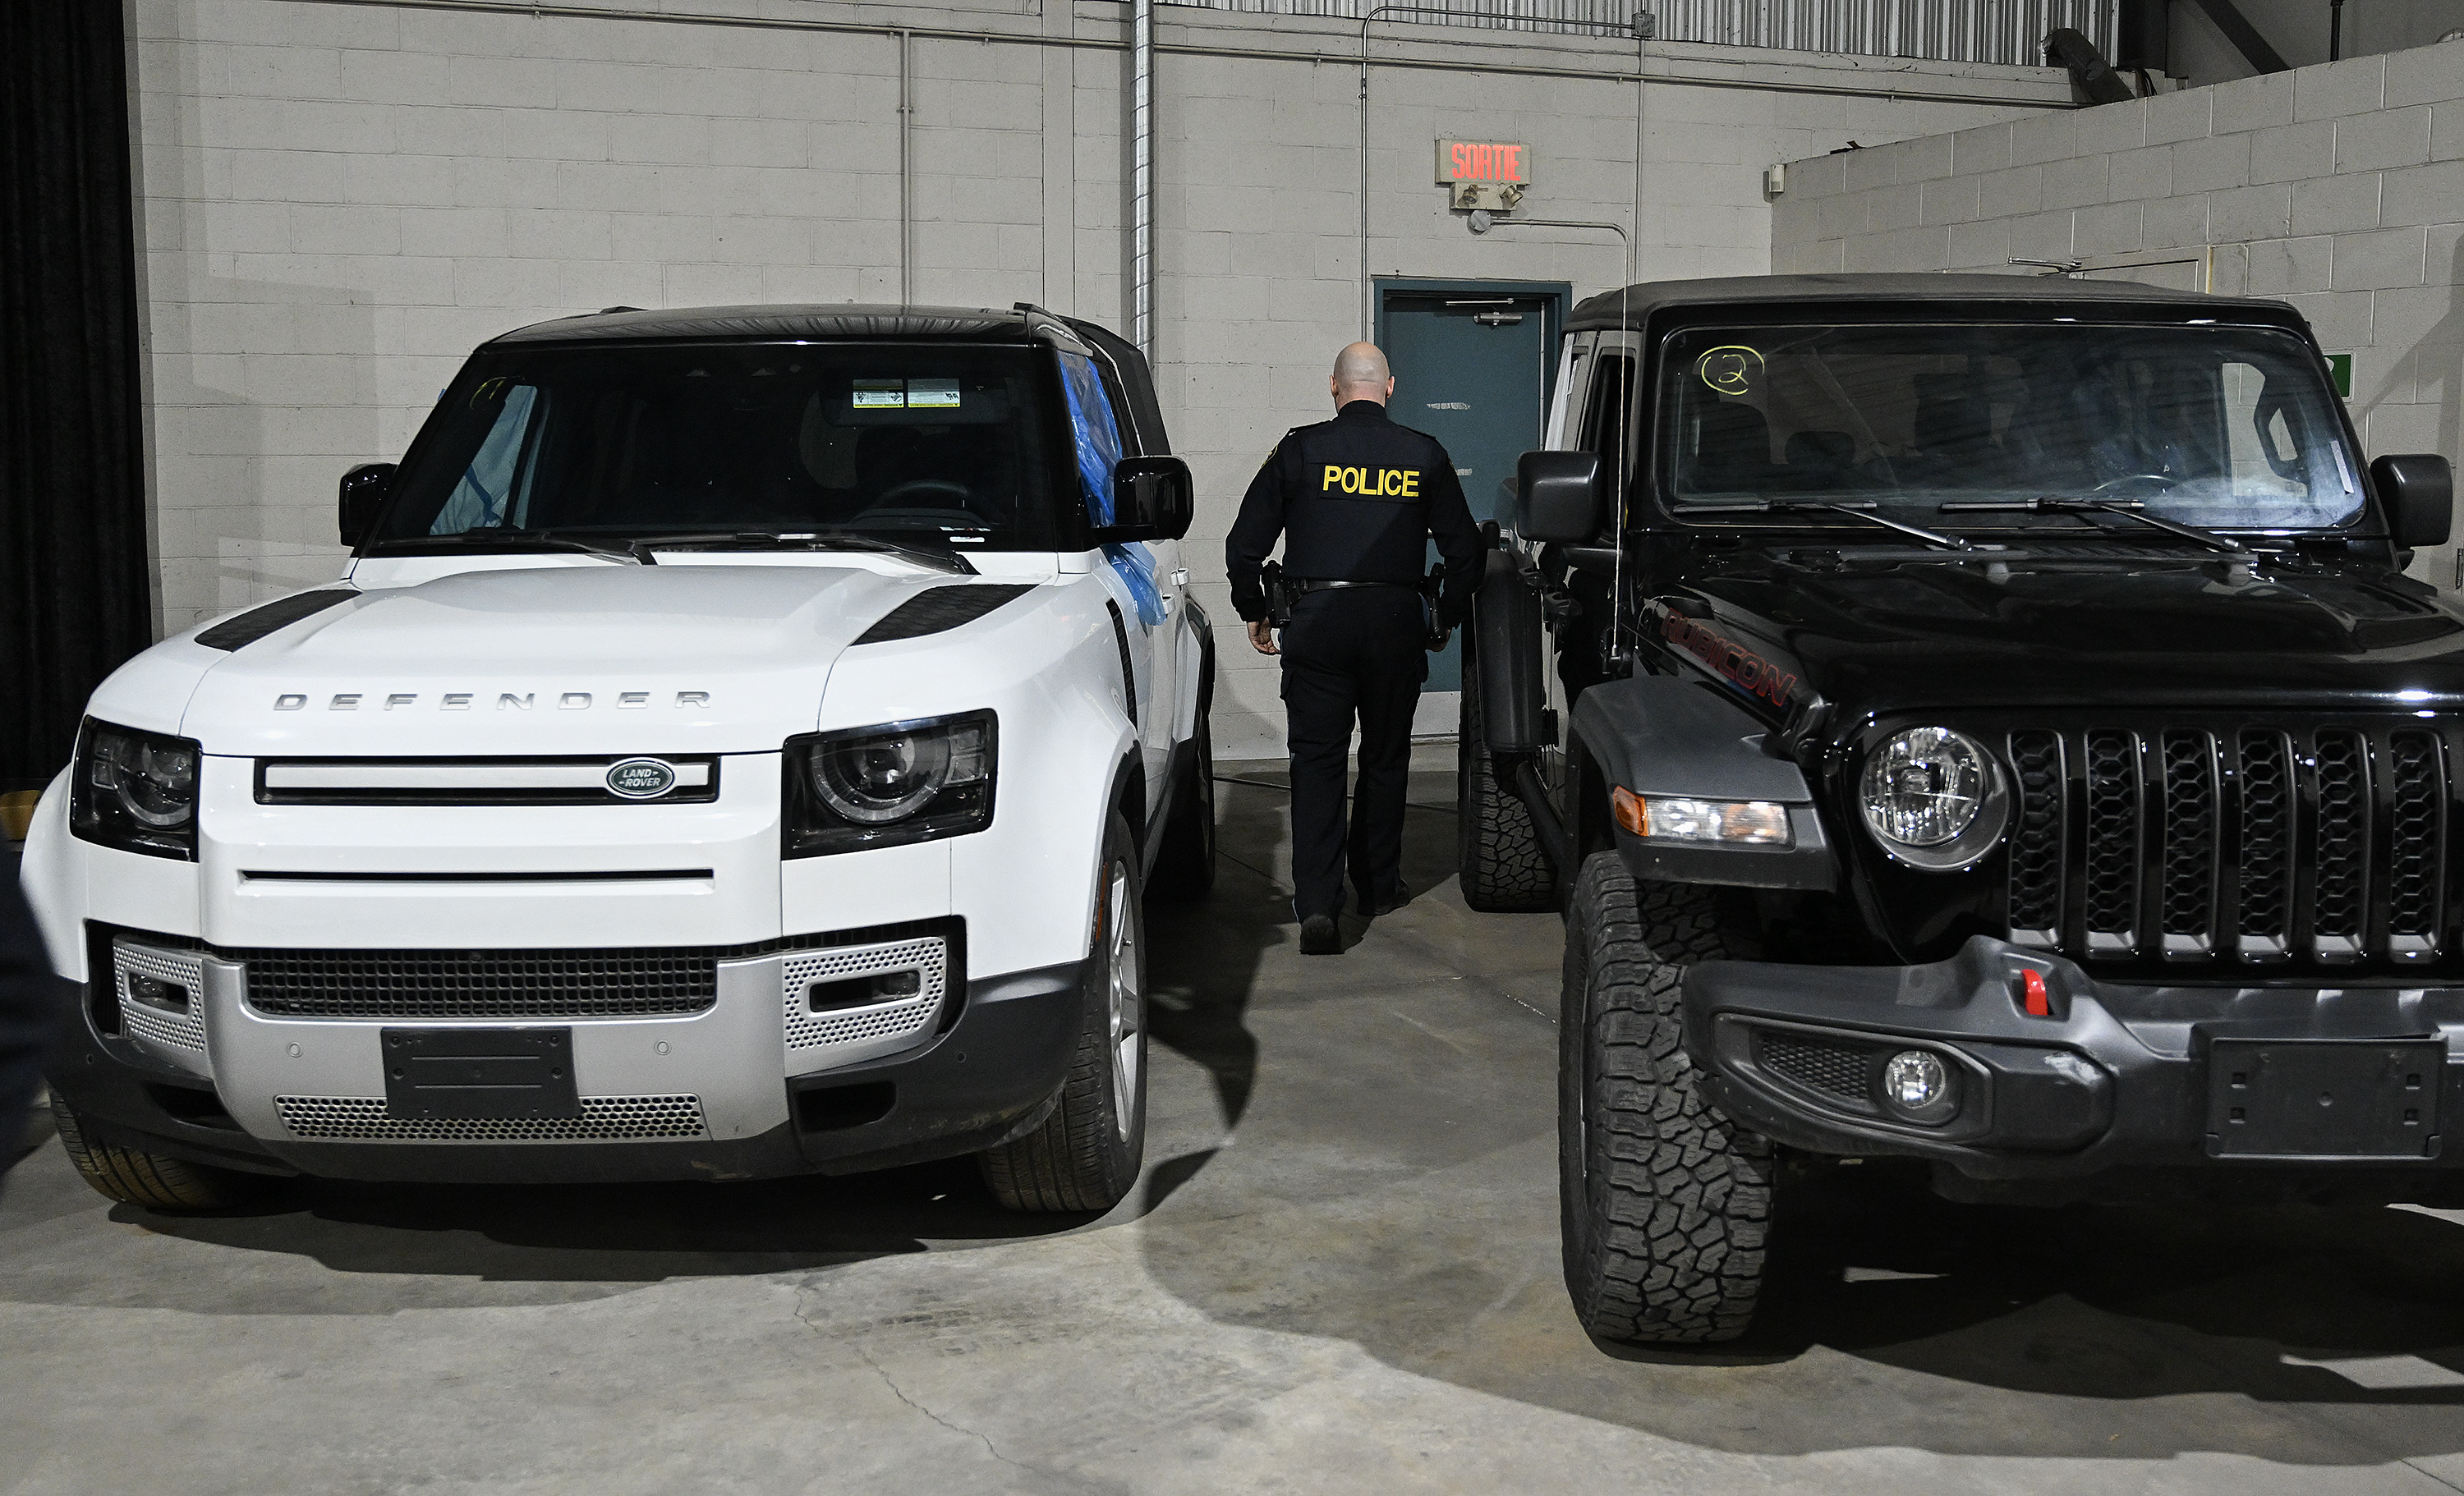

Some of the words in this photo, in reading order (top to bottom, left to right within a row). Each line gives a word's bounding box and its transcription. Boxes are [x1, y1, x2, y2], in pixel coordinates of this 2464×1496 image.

[1451, 143, 1522, 181] SORTIE
[1718, 354, 1749, 385] 2
[1322, 465, 1420, 498] POLICE
[1660, 607, 1797, 707] RUBICON
[272, 691, 711, 711] DEFENDER
